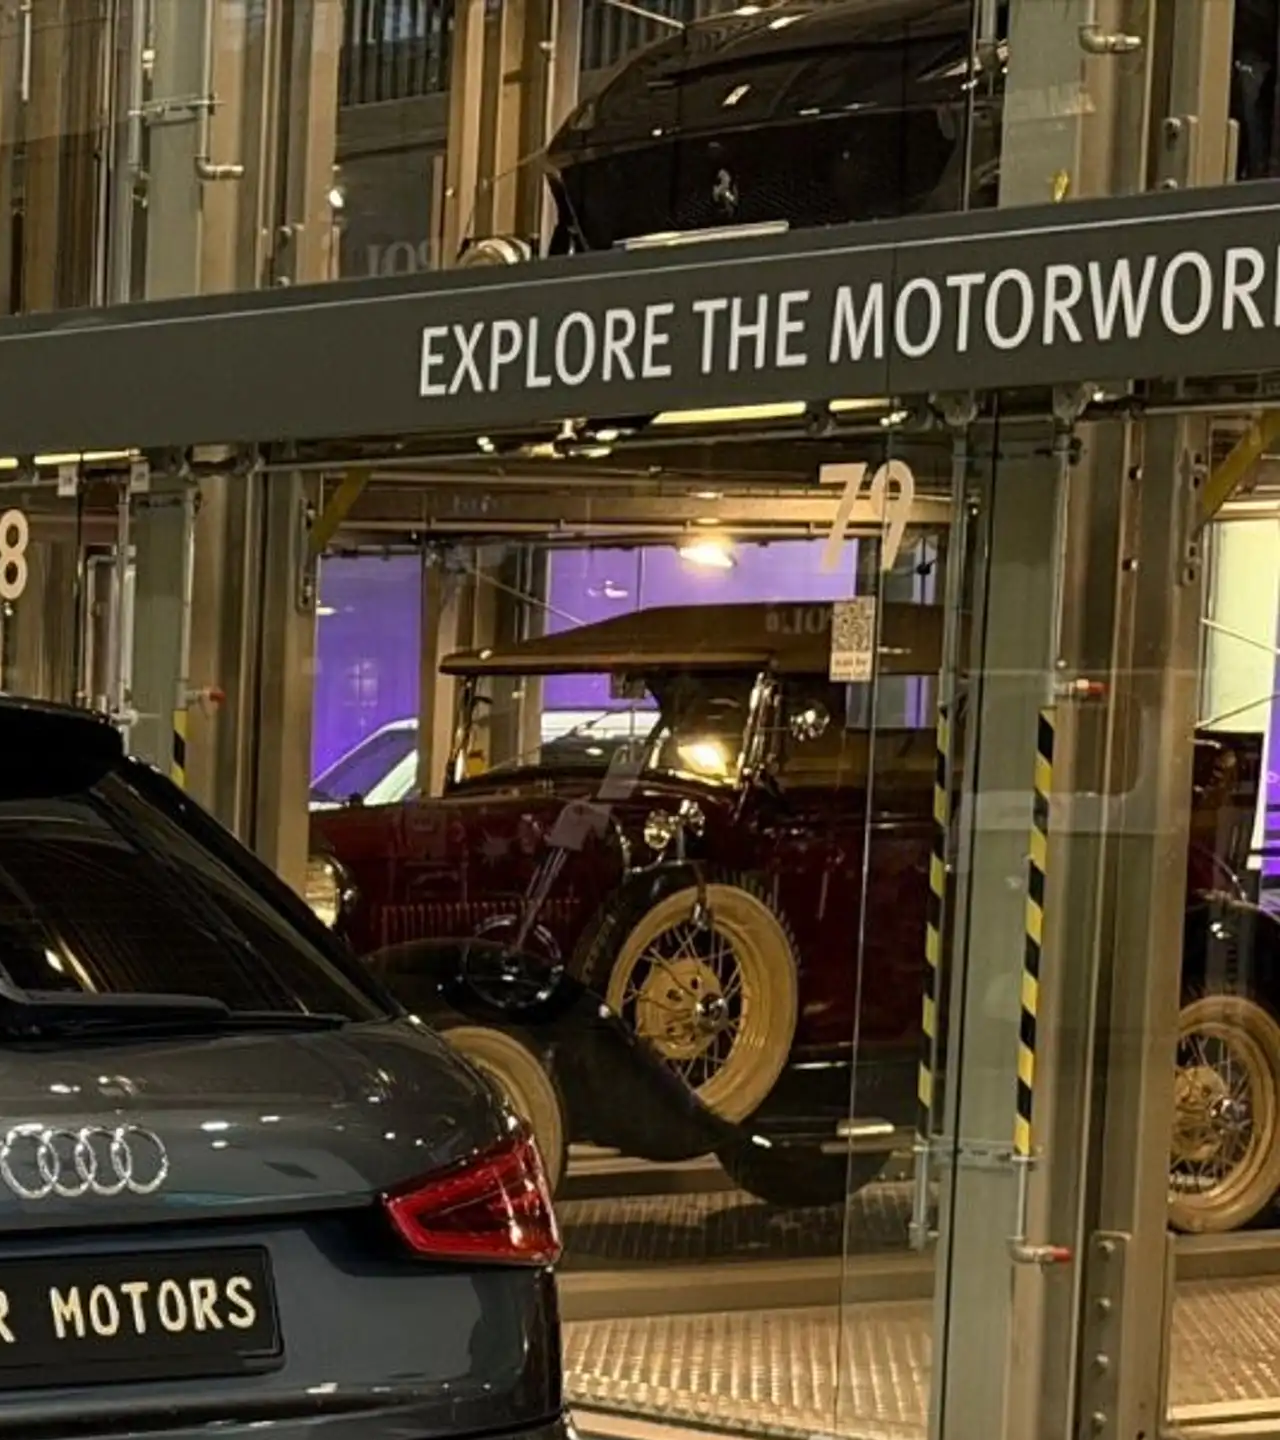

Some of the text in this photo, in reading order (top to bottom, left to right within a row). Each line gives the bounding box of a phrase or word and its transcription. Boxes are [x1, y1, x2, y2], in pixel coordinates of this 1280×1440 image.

[419, 244, 1280, 397] EXPLORE THE MOTORWOR
[819, 458, 915, 575] 79
[49, 1276, 257, 1340] MOTORS
